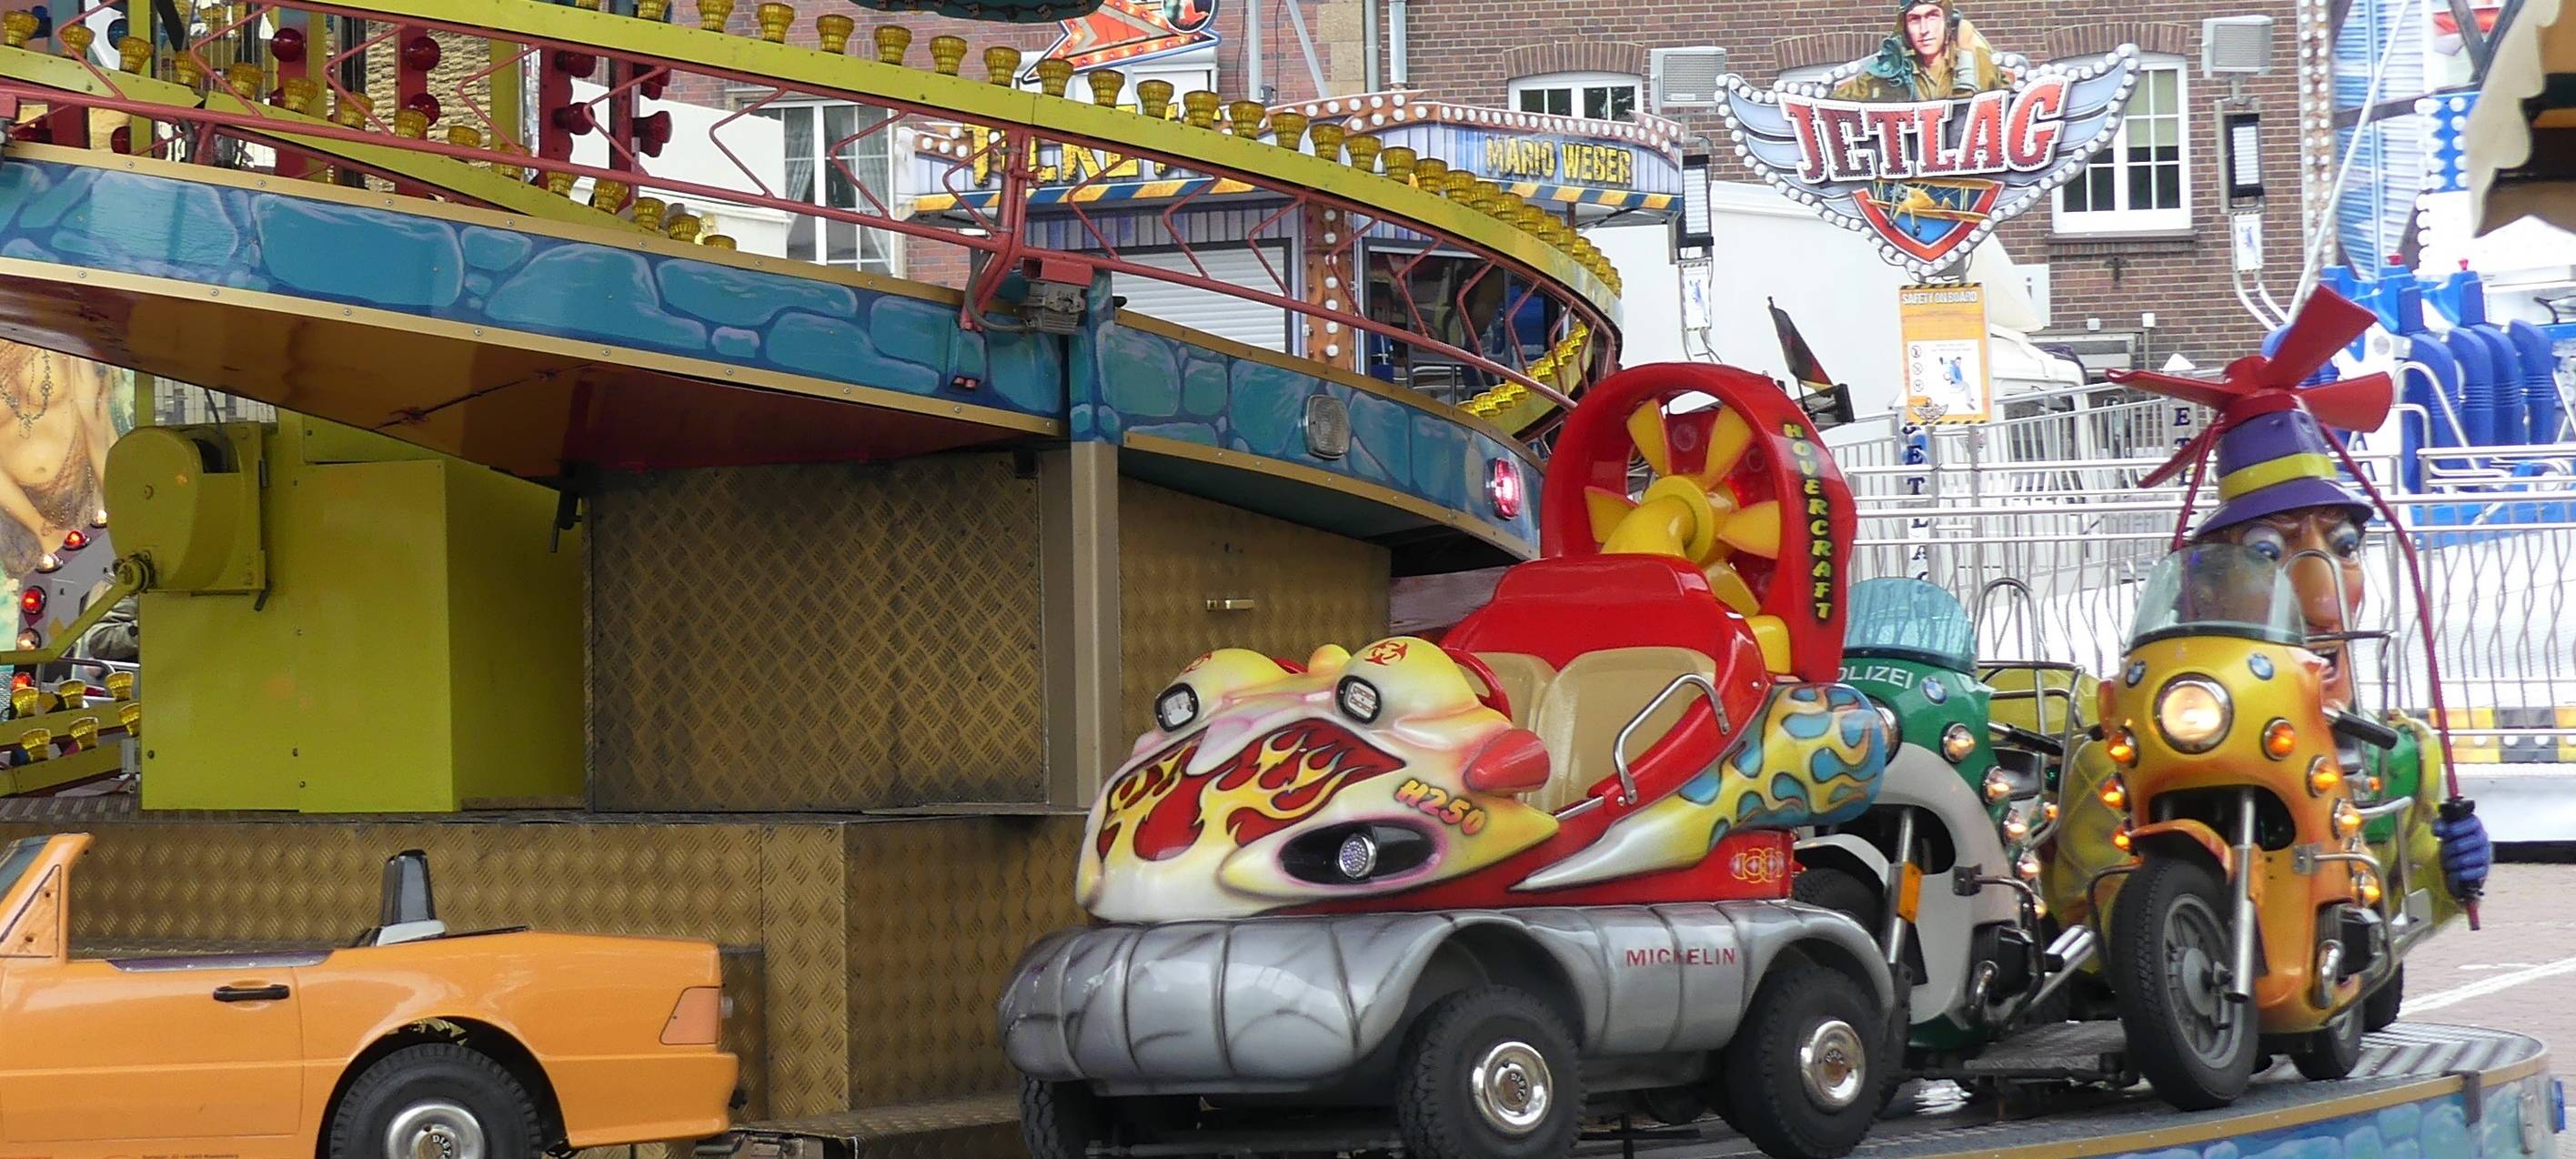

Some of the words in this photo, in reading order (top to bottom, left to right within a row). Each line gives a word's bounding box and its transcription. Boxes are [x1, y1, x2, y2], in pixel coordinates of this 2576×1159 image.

[1778, 75, 2072, 184] JETLAG
[1485, 137, 1556, 178] MARIO
[1560, 141, 1632, 185] WEBER
[1902, 292, 1934, 305] SAFETY
[1782, 421, 1834, 620] HOVERCRAFT
[1394, 779, 1487, 836] H250
